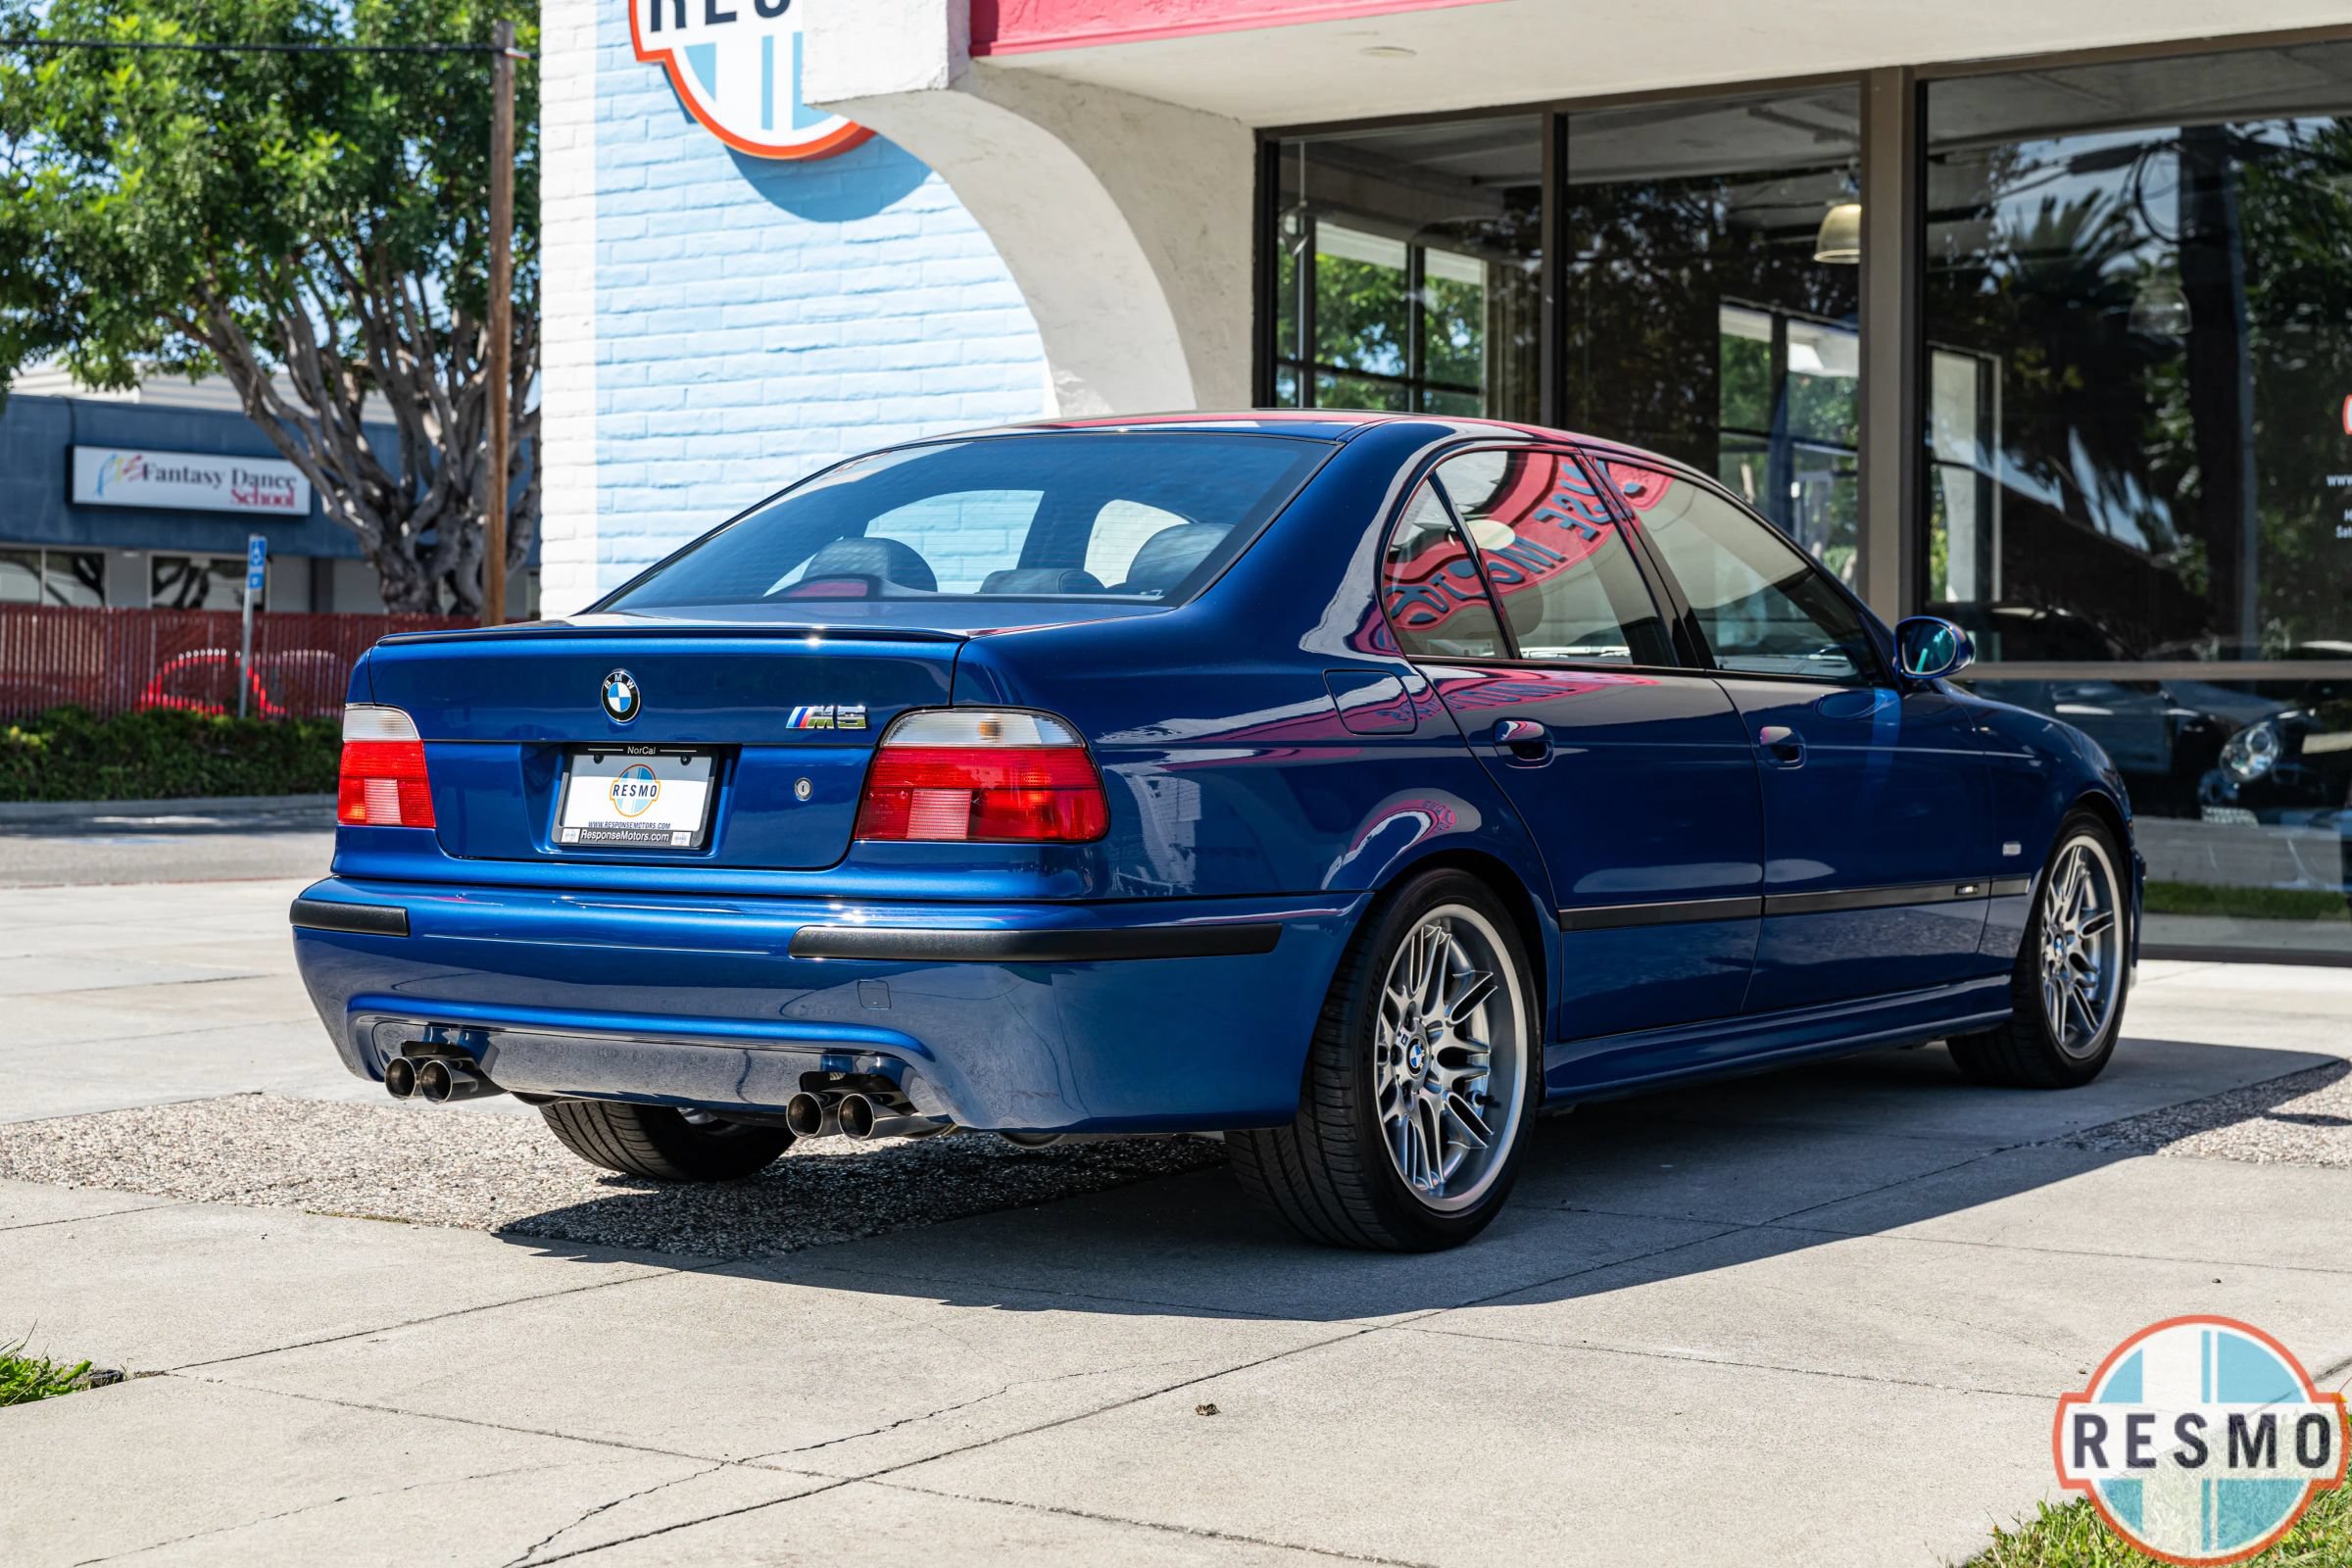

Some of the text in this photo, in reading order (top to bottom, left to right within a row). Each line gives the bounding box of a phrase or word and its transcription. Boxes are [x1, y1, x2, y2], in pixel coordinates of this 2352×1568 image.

[142, 463, 297, 489] Fantasy Dance
[230, 486, 295, 508] School
[604, 673, 635, 690] BMW
[804, 705, 867, 729] M5
[626, 746, 657, 756] NorCal
[612, 784, 658, 798] RESMO
[580, 830, 670, 843] ResponseMotors.com
